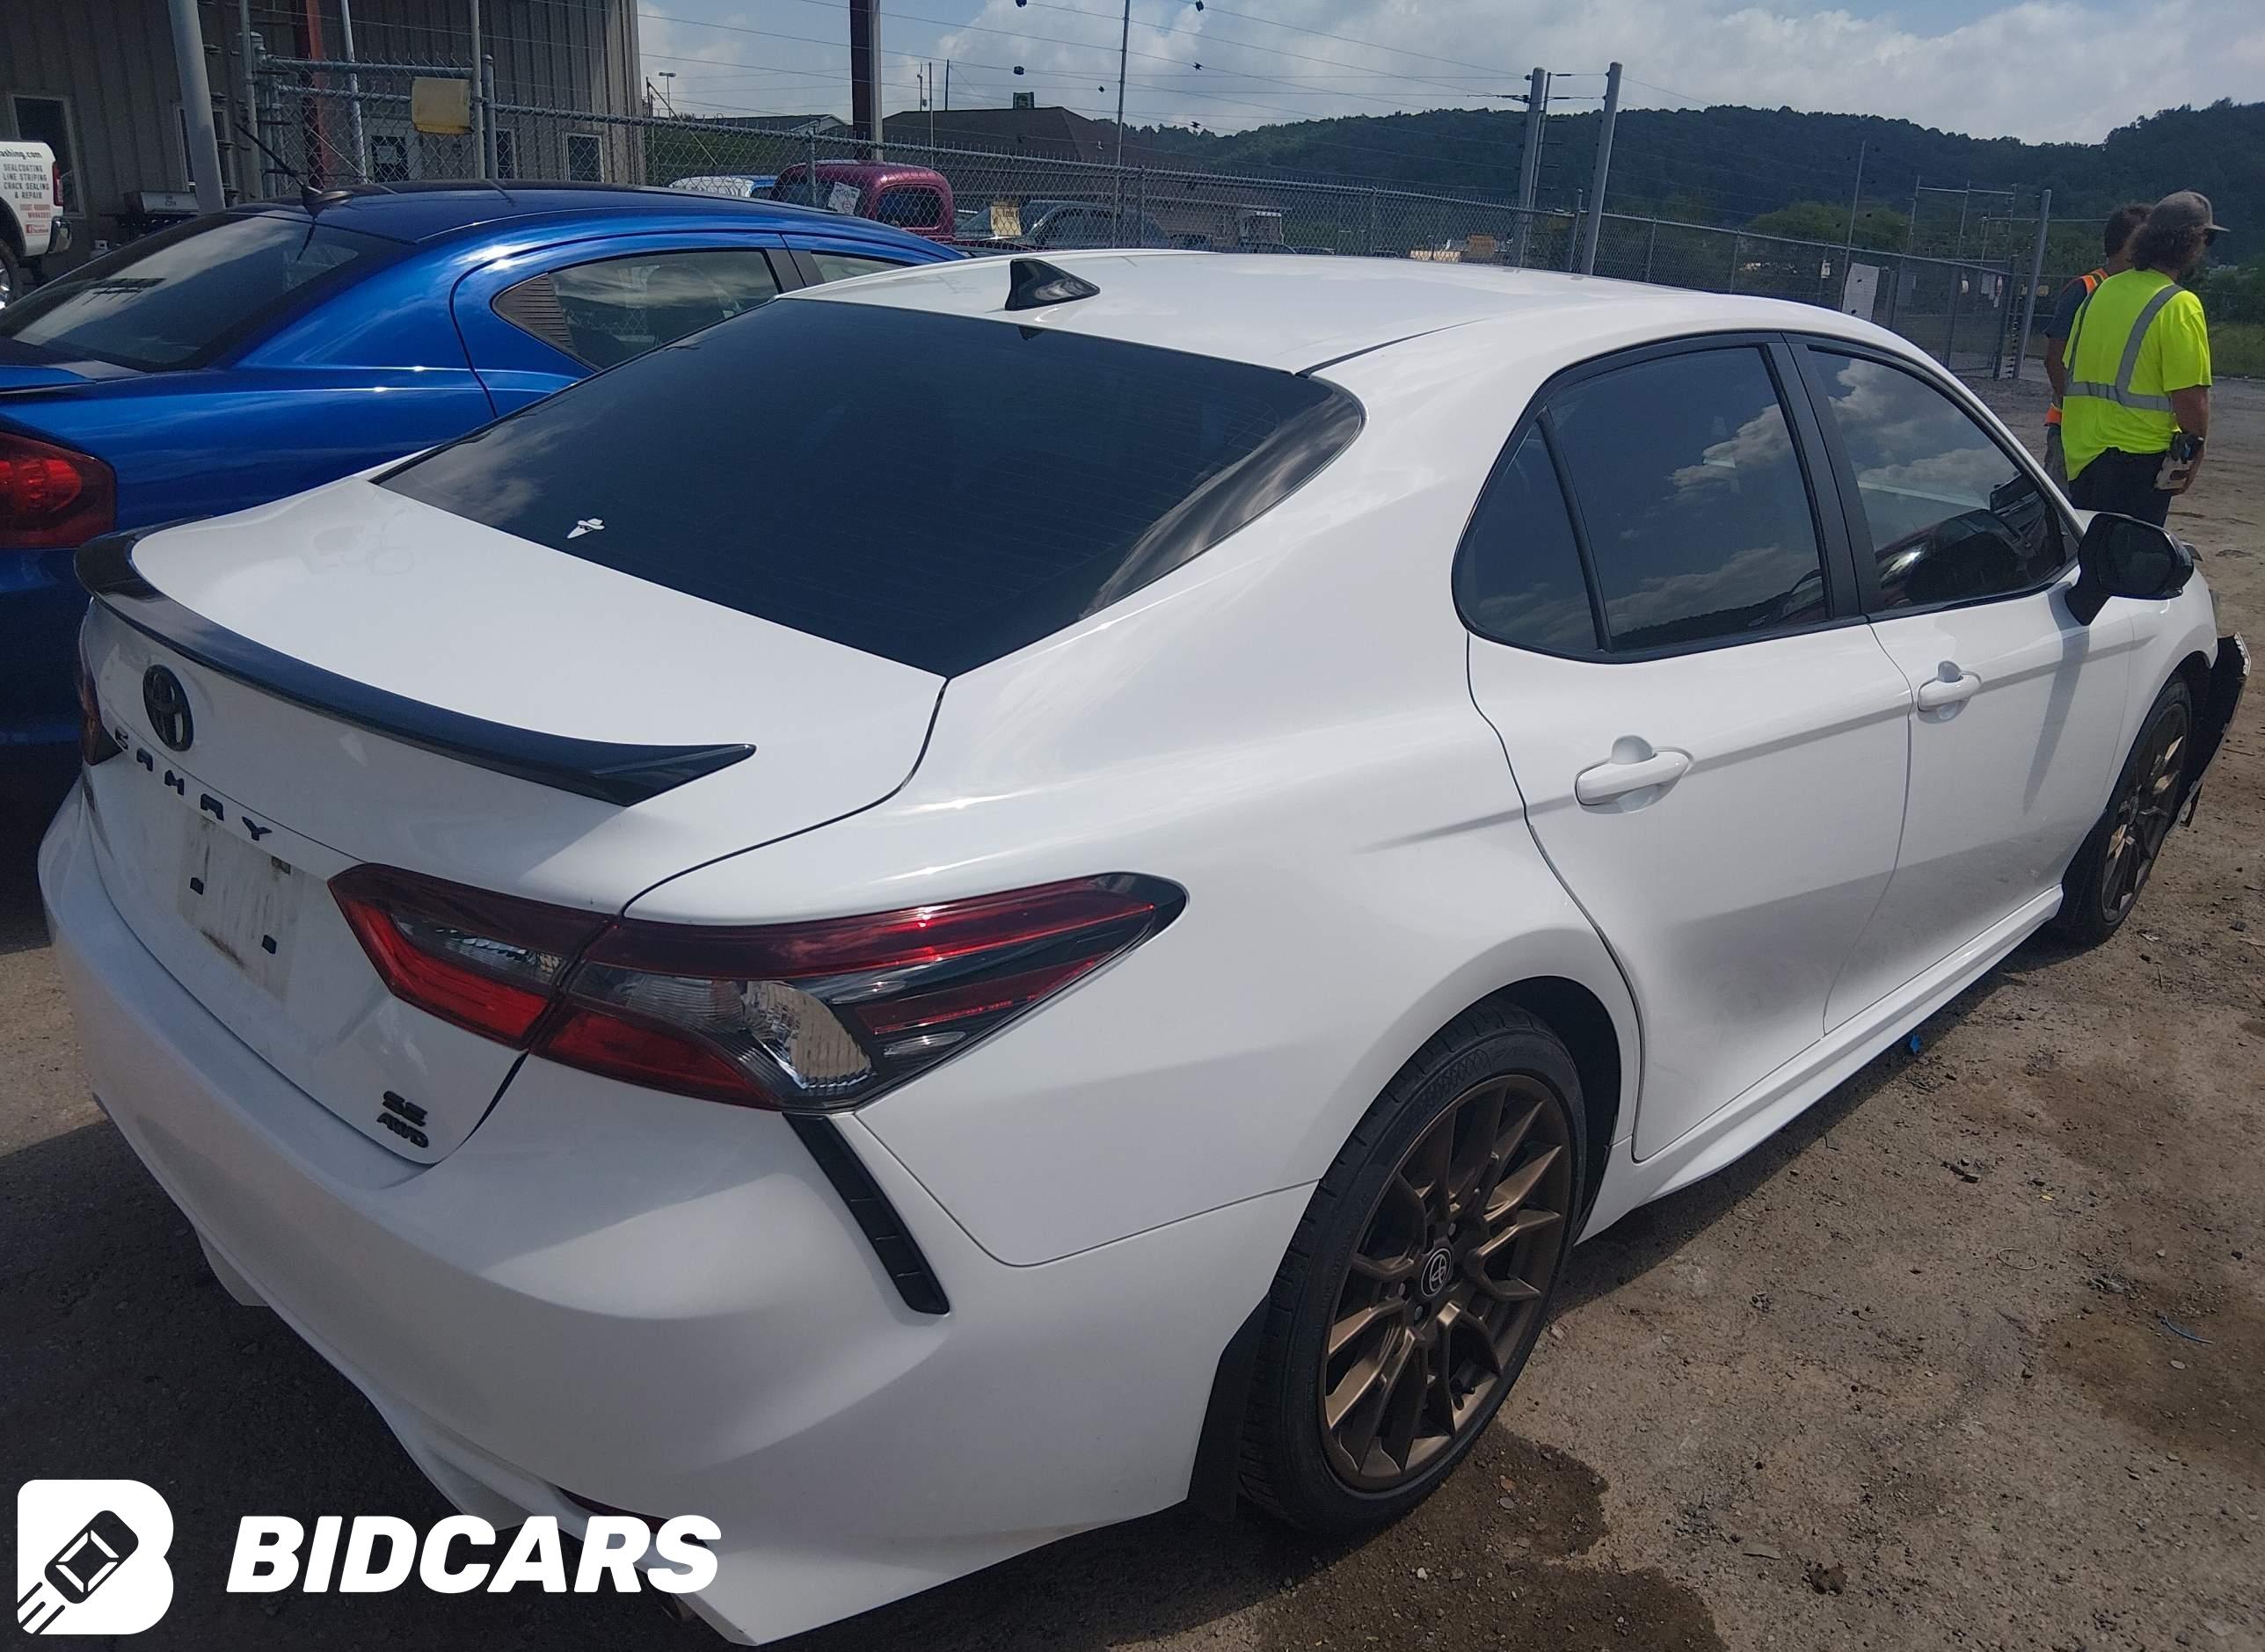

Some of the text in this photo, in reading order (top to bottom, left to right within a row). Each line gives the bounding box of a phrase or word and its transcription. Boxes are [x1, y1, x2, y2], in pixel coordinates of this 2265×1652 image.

[3, 164, 43, 172] SEALCOATING
[382, 1090, 428, 1126] SE
[376, 1112, 429, 1148] AWD
